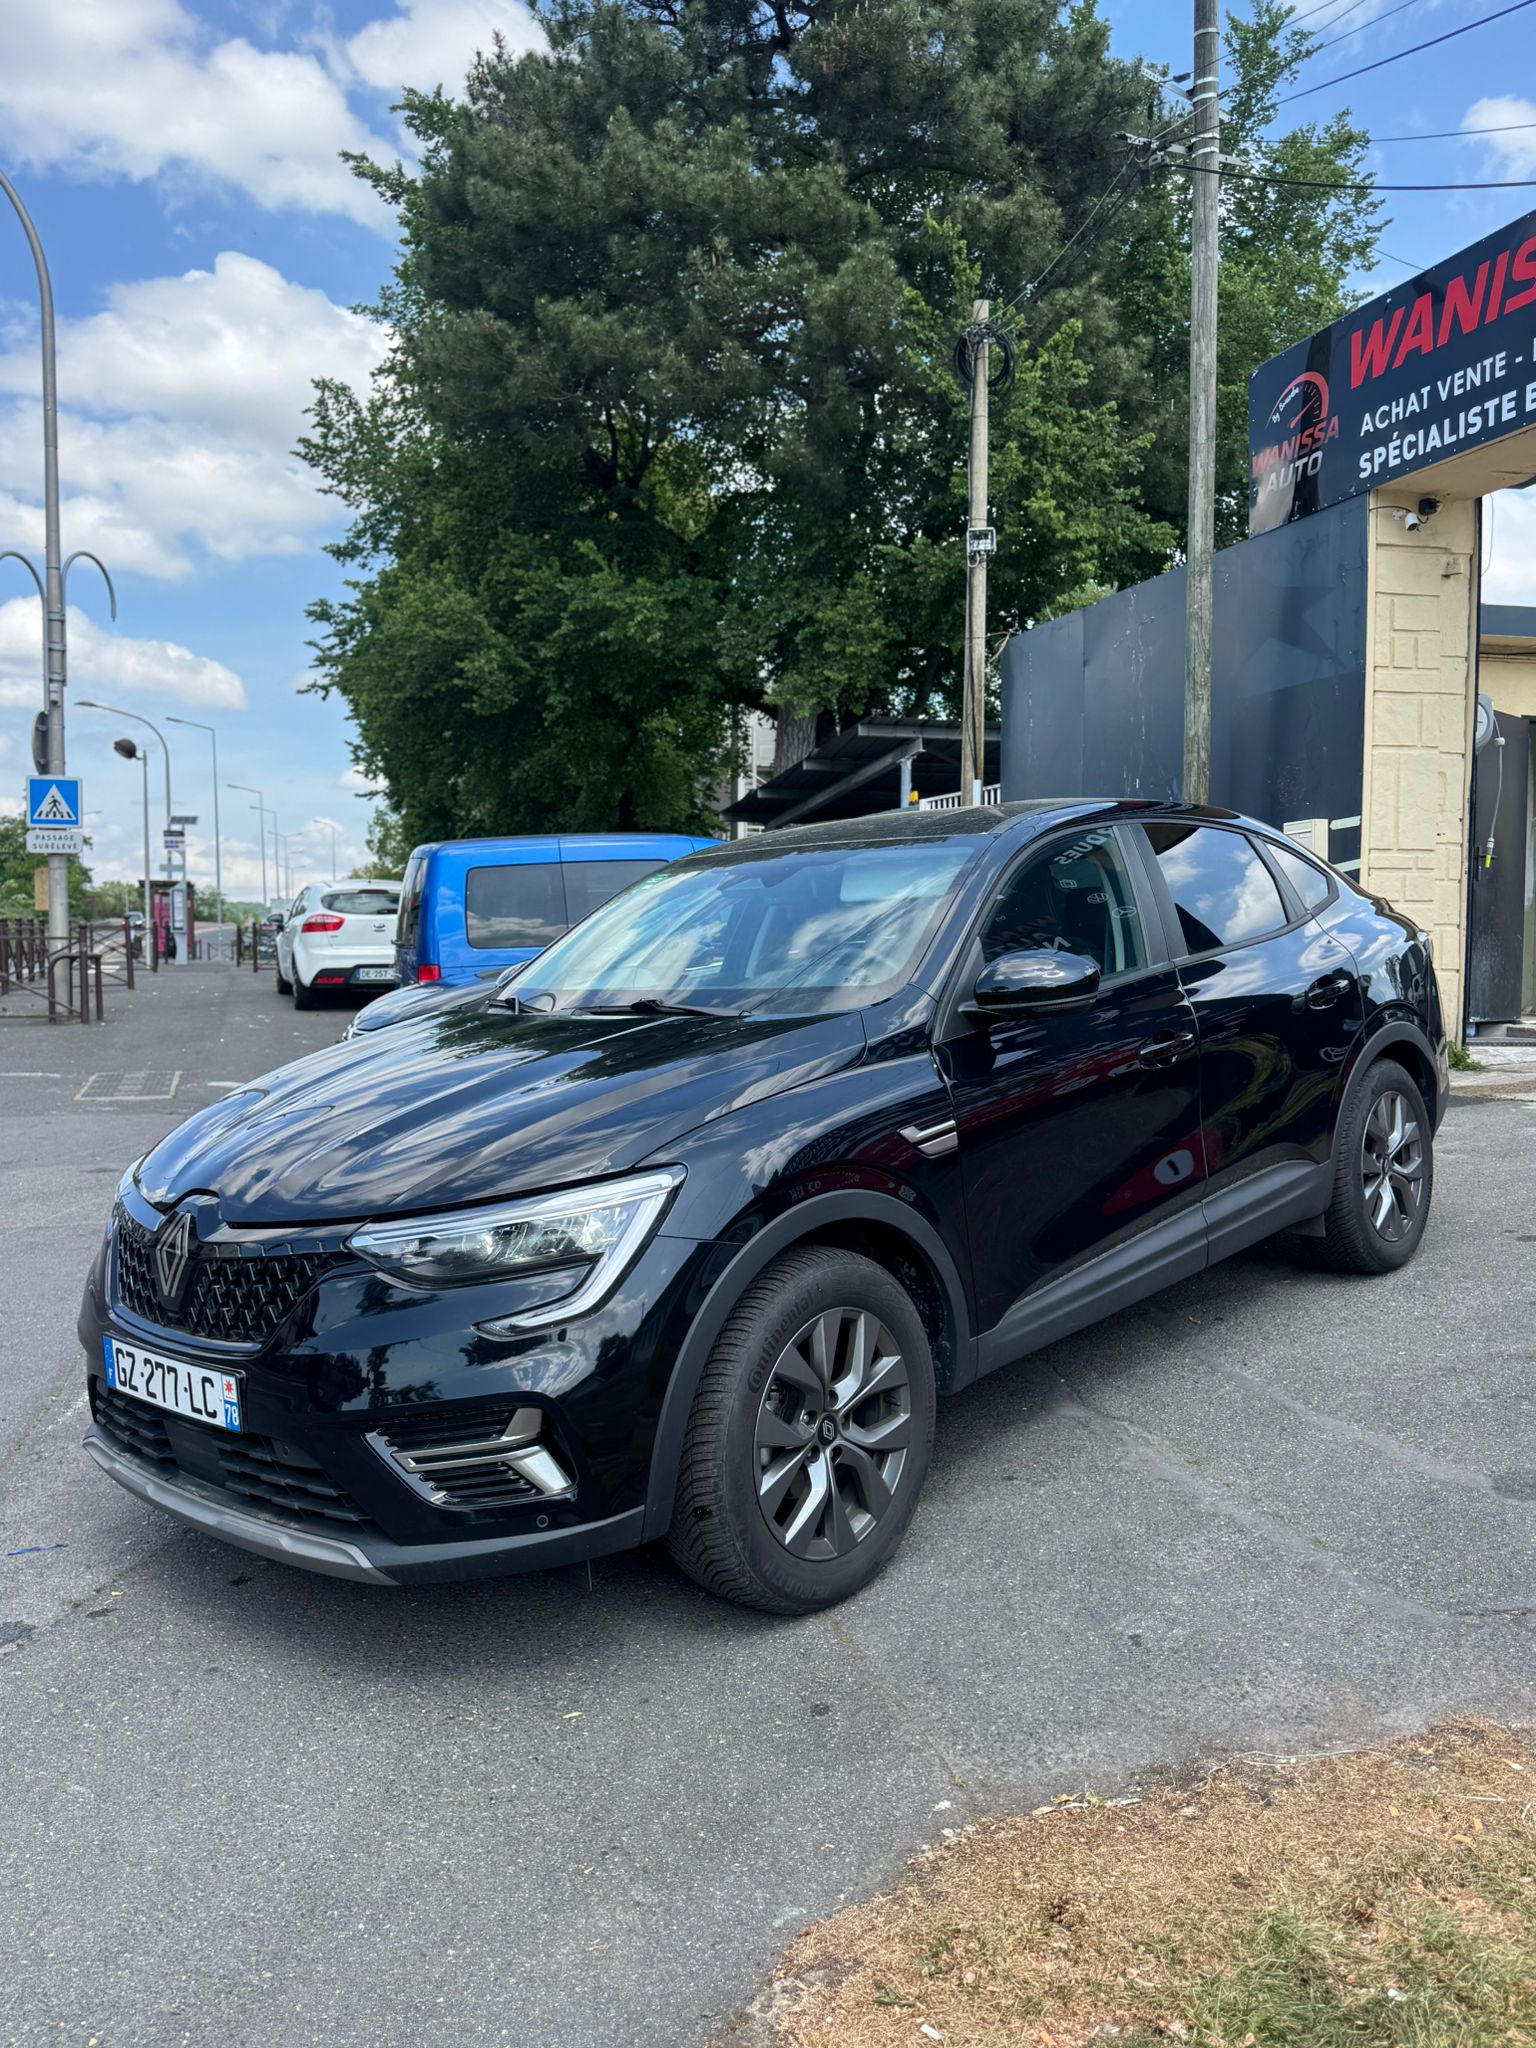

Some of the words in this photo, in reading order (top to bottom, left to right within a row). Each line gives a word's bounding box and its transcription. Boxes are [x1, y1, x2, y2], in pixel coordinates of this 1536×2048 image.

[1360, 385, 1431, 437] ACHAT
[1437, 351, 1506, 402] VENTE
[1252, 415, 1339, 479] WANISSA
[1359, 390, 1517, 479] SPÉCIALISTE
[1265, 450, 1323, 493] AUTO
[224, 1403, 240, 1427] 78
